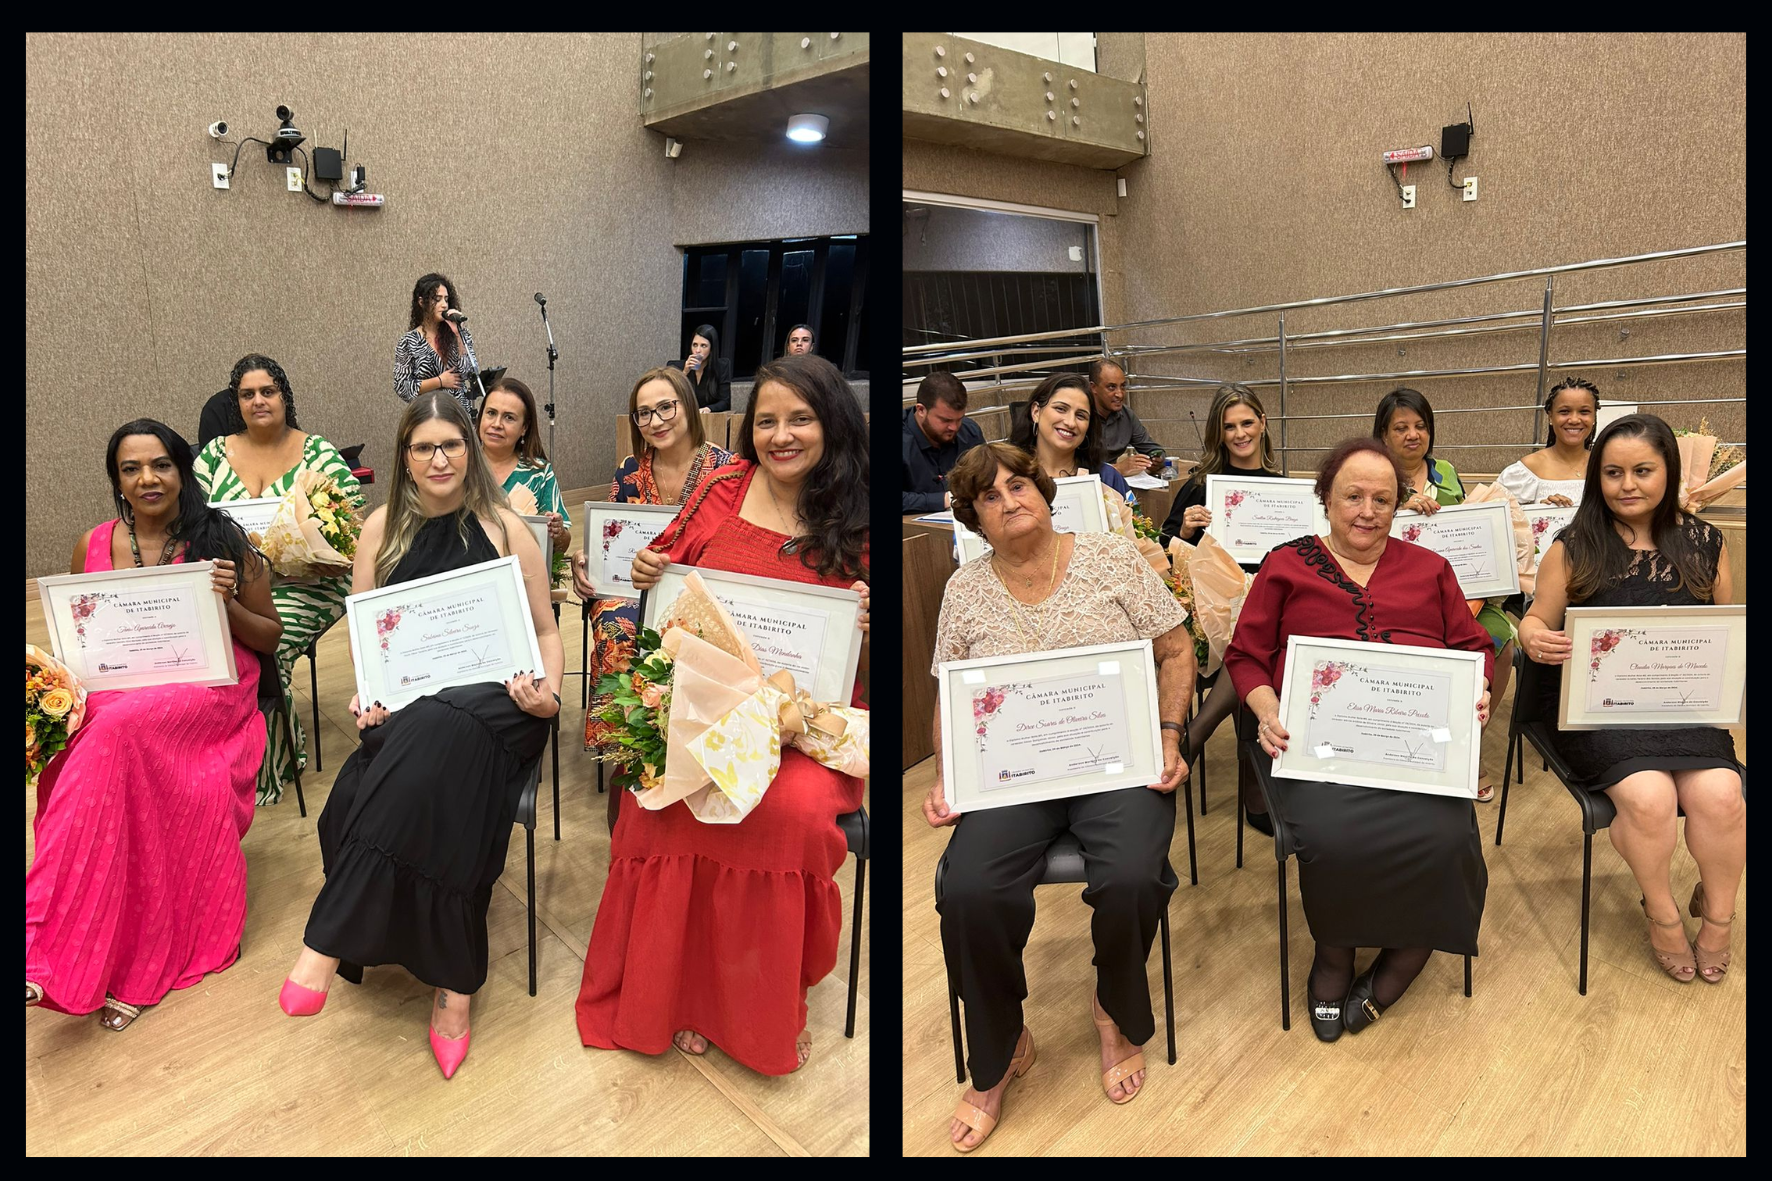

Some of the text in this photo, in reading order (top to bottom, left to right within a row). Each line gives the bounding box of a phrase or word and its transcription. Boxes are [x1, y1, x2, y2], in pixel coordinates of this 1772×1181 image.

[418, 597, 484, 617] CÂMARA MUNICIPAL
[440, 606, 474, 618] ITABIRITO
[750, 622, 792, 635] ITABIRITO
[760, 617, 807, 630] MUNICIPAL
[1360, 678, 1435, 690] CÂMARA MUNICIPAL
[1026, 683, 1106, 700] CÂMARA MUNICIPAL
[1383, 688, 1422, 696] ITABIRITO
[1053, 692, 1094, 704] ITABIRITO
